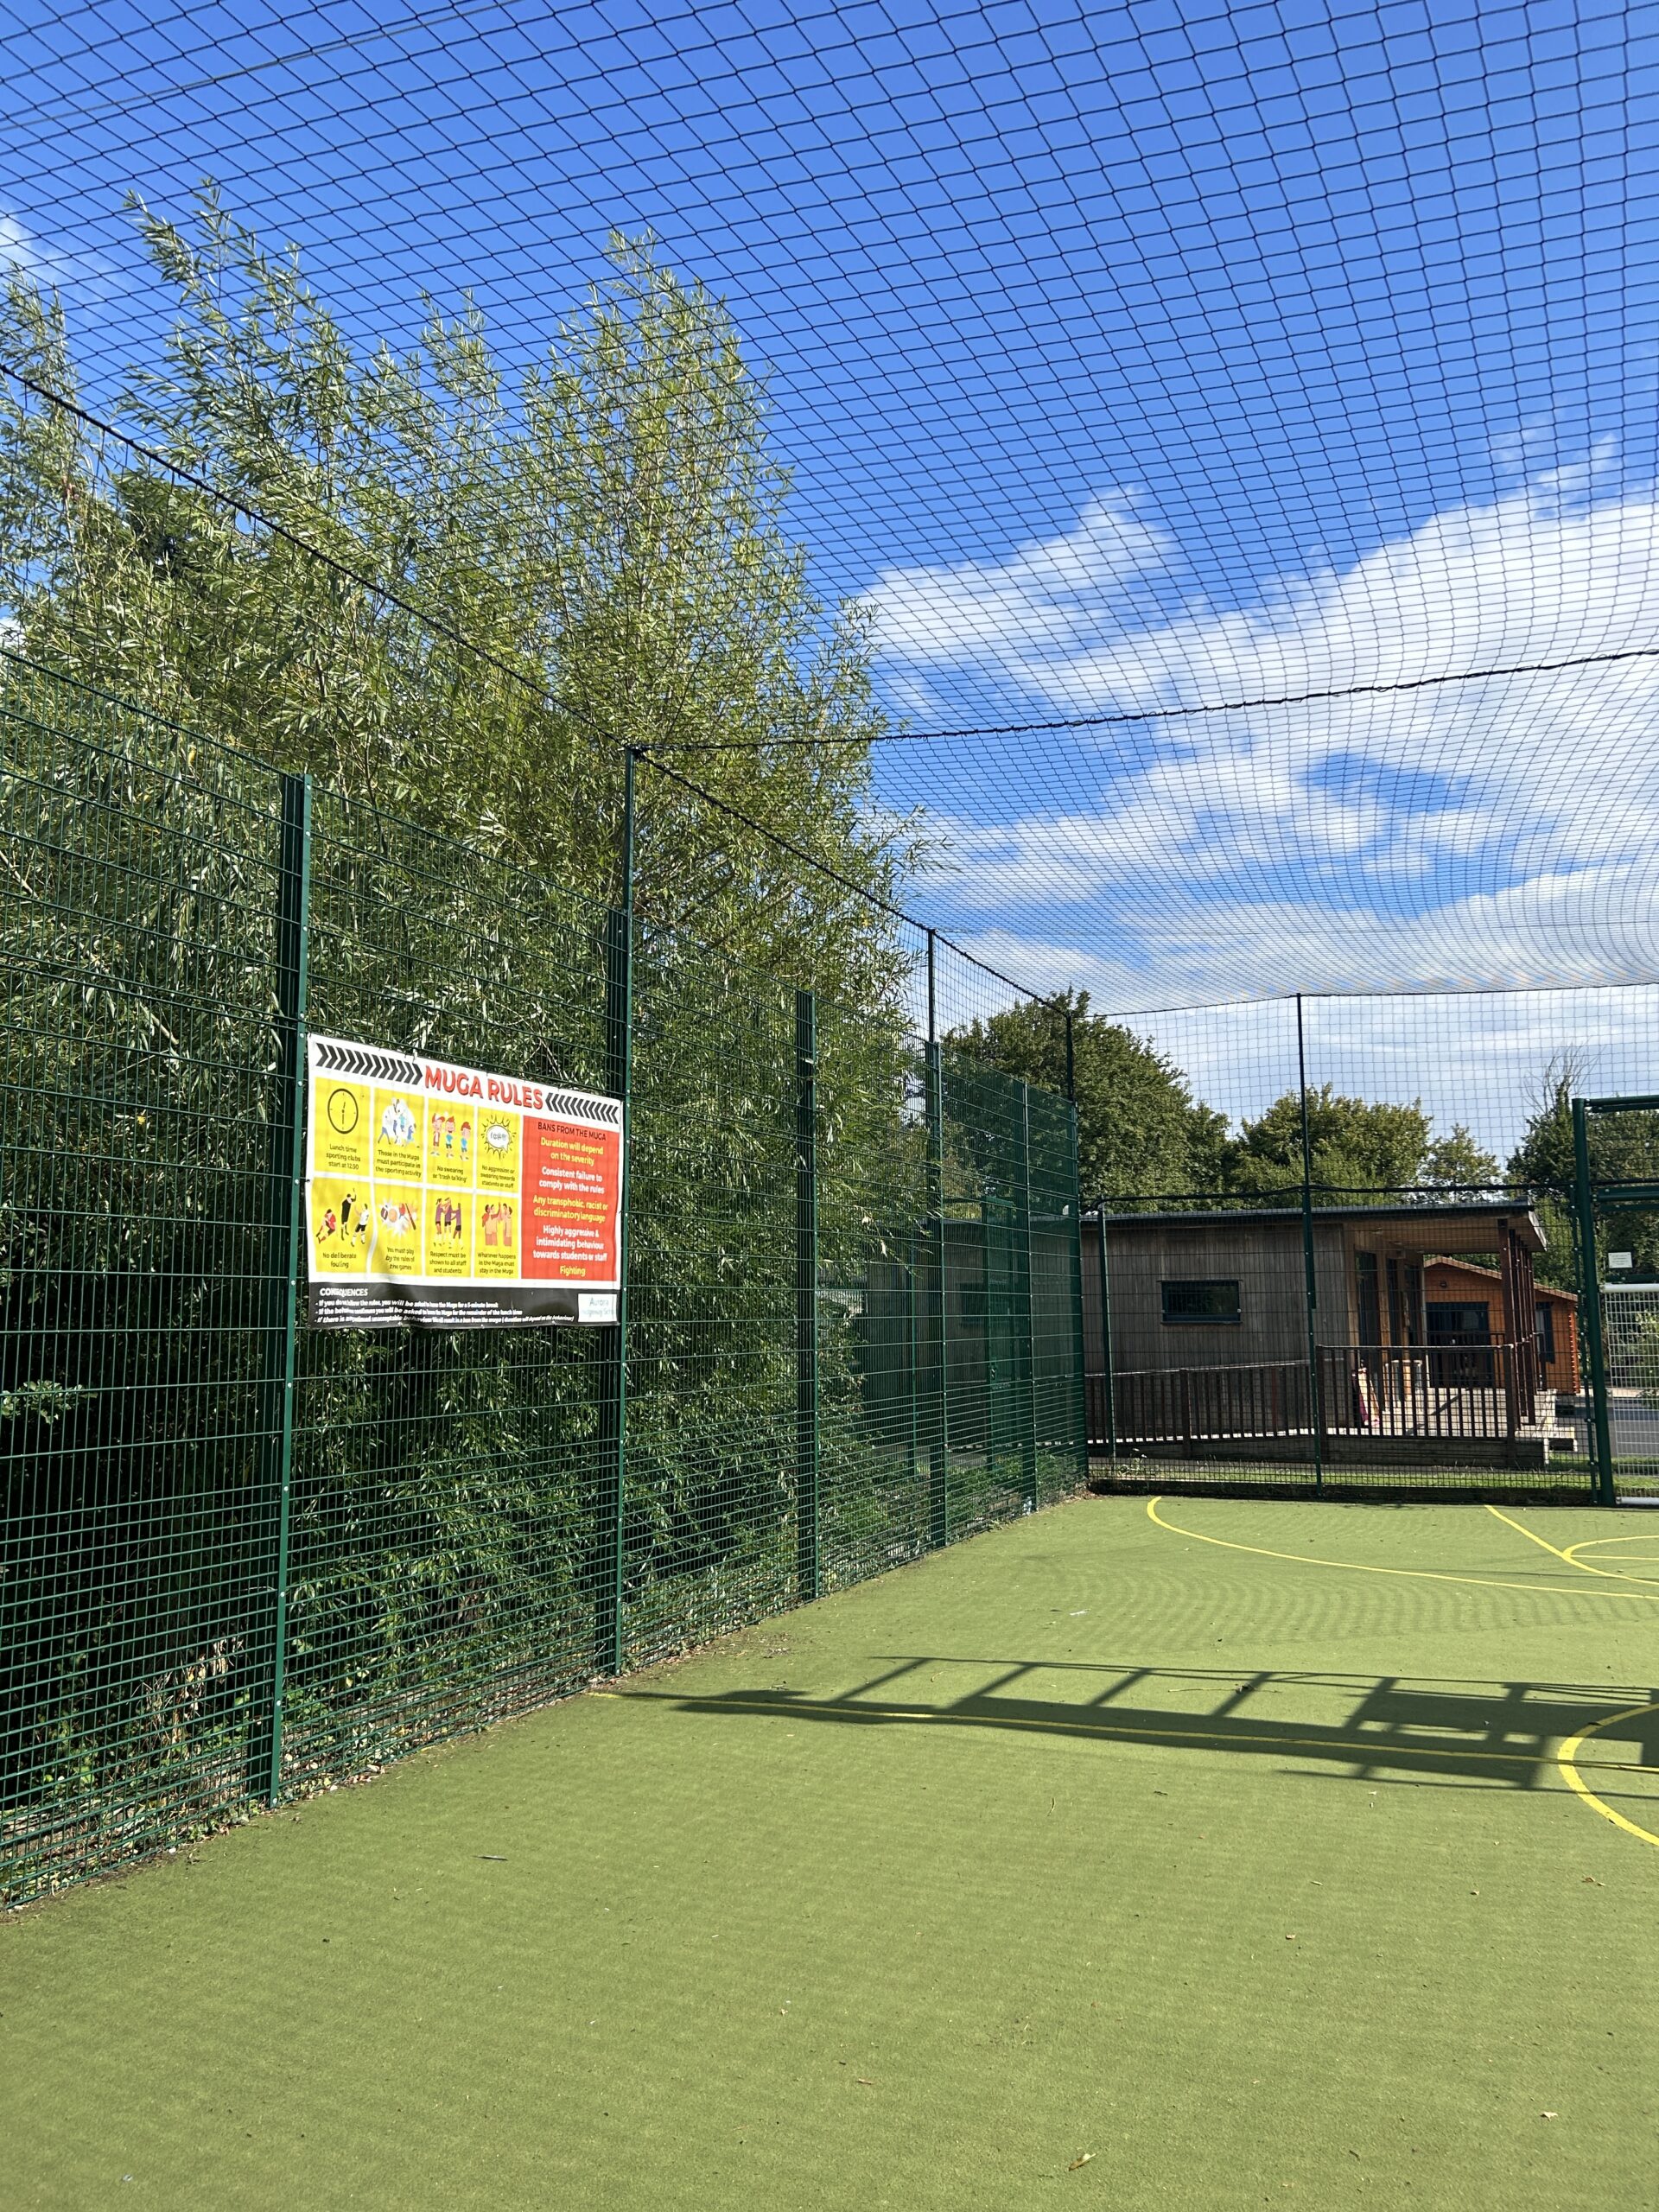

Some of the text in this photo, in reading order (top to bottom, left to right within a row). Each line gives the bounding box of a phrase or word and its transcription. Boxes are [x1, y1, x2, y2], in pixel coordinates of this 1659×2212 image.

[425, 1065, 543, 1109] MUGA RULES
[537, 1122, 607, 1141] BANS FROM THE MUGA
[541, 1137, 604, 1155] Duration will depend
[326, 1152, 347, 1161] sporting
[560, 1153, 571, 1161] the
[571, 1155, 594, 1166] severity
[390, 1159, 415, 1168] participate
[385, 1166, 404, 1176] sporting
[405, 1169, 422, 1178] activity
[444, 1166, 464, 1175] swearing
[542, 1166, 575, 1179] Consistent
[575, 1171, 595, 1181] failure
[539, 1179, 605, 1194] comply with the rules
[533, 1195, 546, 1206] Any
[547, 1197, 585, 1209] transphobic,
[586, 1200, 601, 1210] racist
[533, 1207, 606, 1224] discriminatory language
[543, 1224, 563, 1236] Highly
[564, 1228, 594, 1238] aggressive
[536, 1236, 604, 1249] intimidating behaviour
[533, 1249, 560, 1260] towards
[561, 1250, 588, 1261] students
[594, 1252, 607, 1262] staff
[559, 1265, 586, 1276] Fighting
